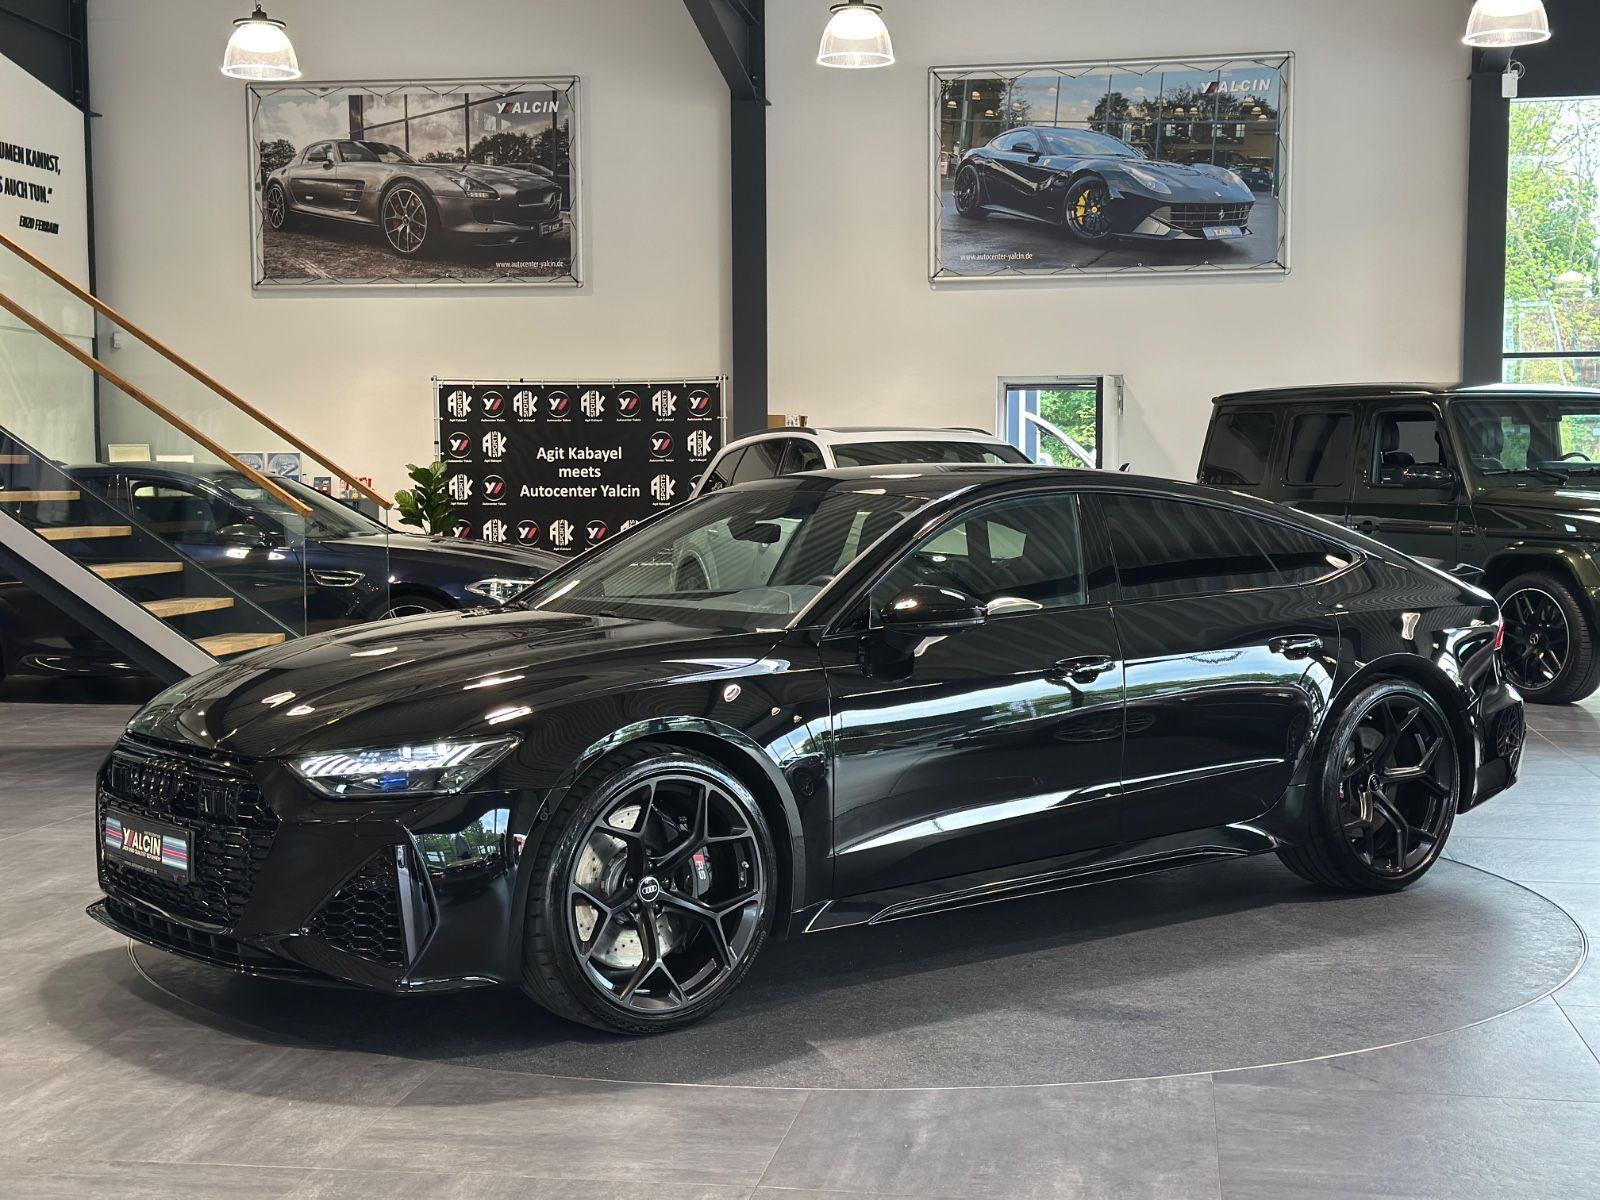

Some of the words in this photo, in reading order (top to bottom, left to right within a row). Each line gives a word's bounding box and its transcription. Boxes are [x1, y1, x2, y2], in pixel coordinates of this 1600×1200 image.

[1200, 79, 1271, 94] YALCIN
[496, 101, 559, 114] YALCIN
[26, 148, 61, 176] KANNST,
[4, 177, 28, 199] AUCH
[537, 447, 564, 463] Agit
[569, 446, 622, 462] Kabayel
[559, 467, 601, 478] meets
[520, 485, 597, 497] Autocenter
[601, 484, 640, 497] Yalcin
[123, 827, 161, 856] YALCIN
[695, 860, 706, 880] RS
